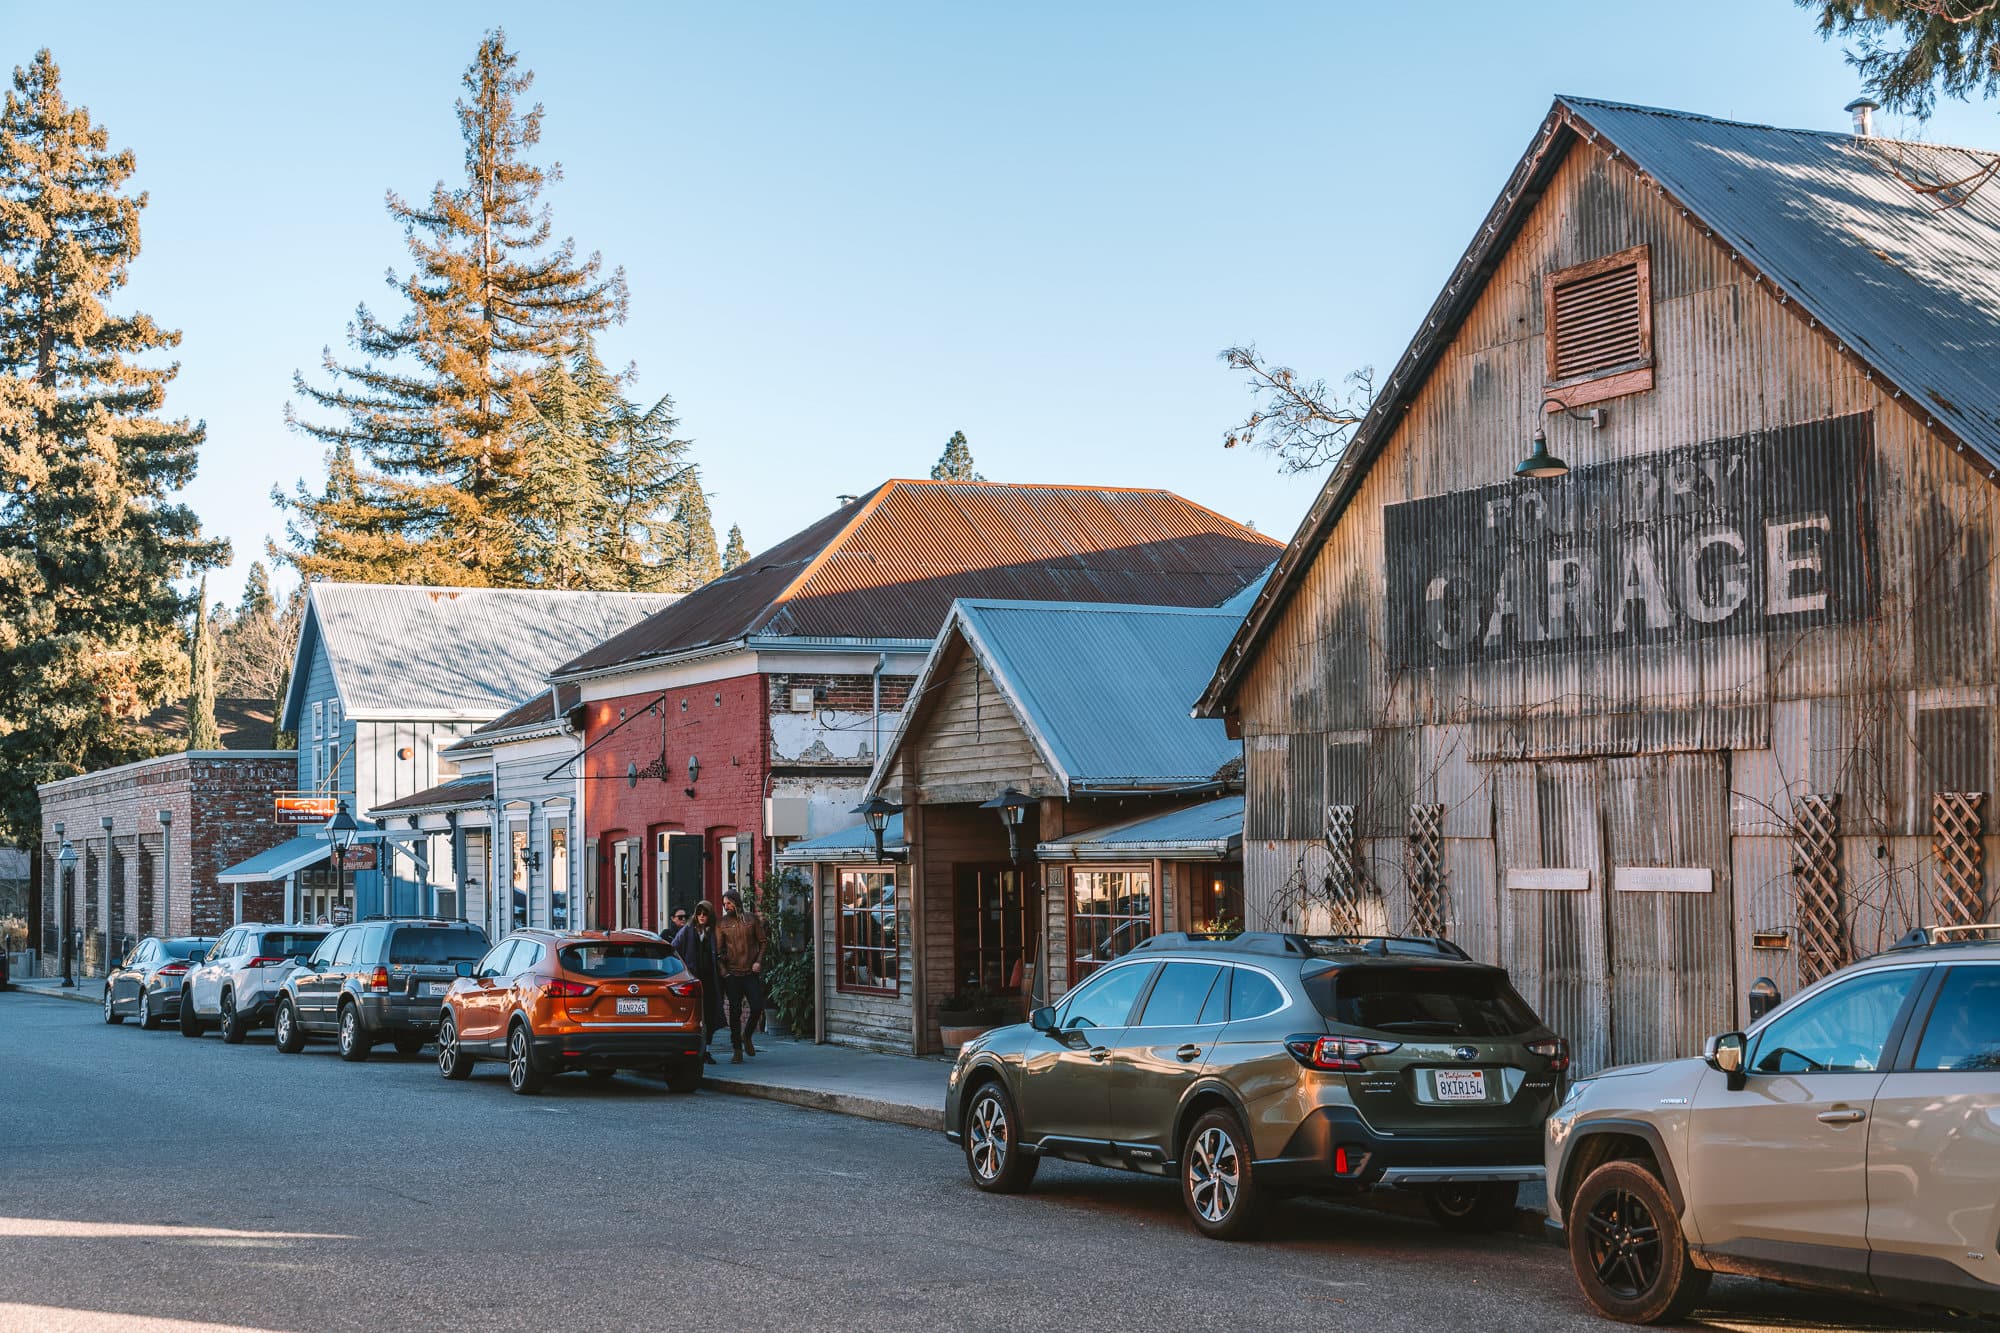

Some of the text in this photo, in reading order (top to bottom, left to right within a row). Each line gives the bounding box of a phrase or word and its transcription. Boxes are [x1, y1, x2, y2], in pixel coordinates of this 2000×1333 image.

[1487, 454, 1742, 545] FODRY
[1425, 510, 1831, 651] GARAGE
[1440, 1080, 1482, 1095] 8XIR154
